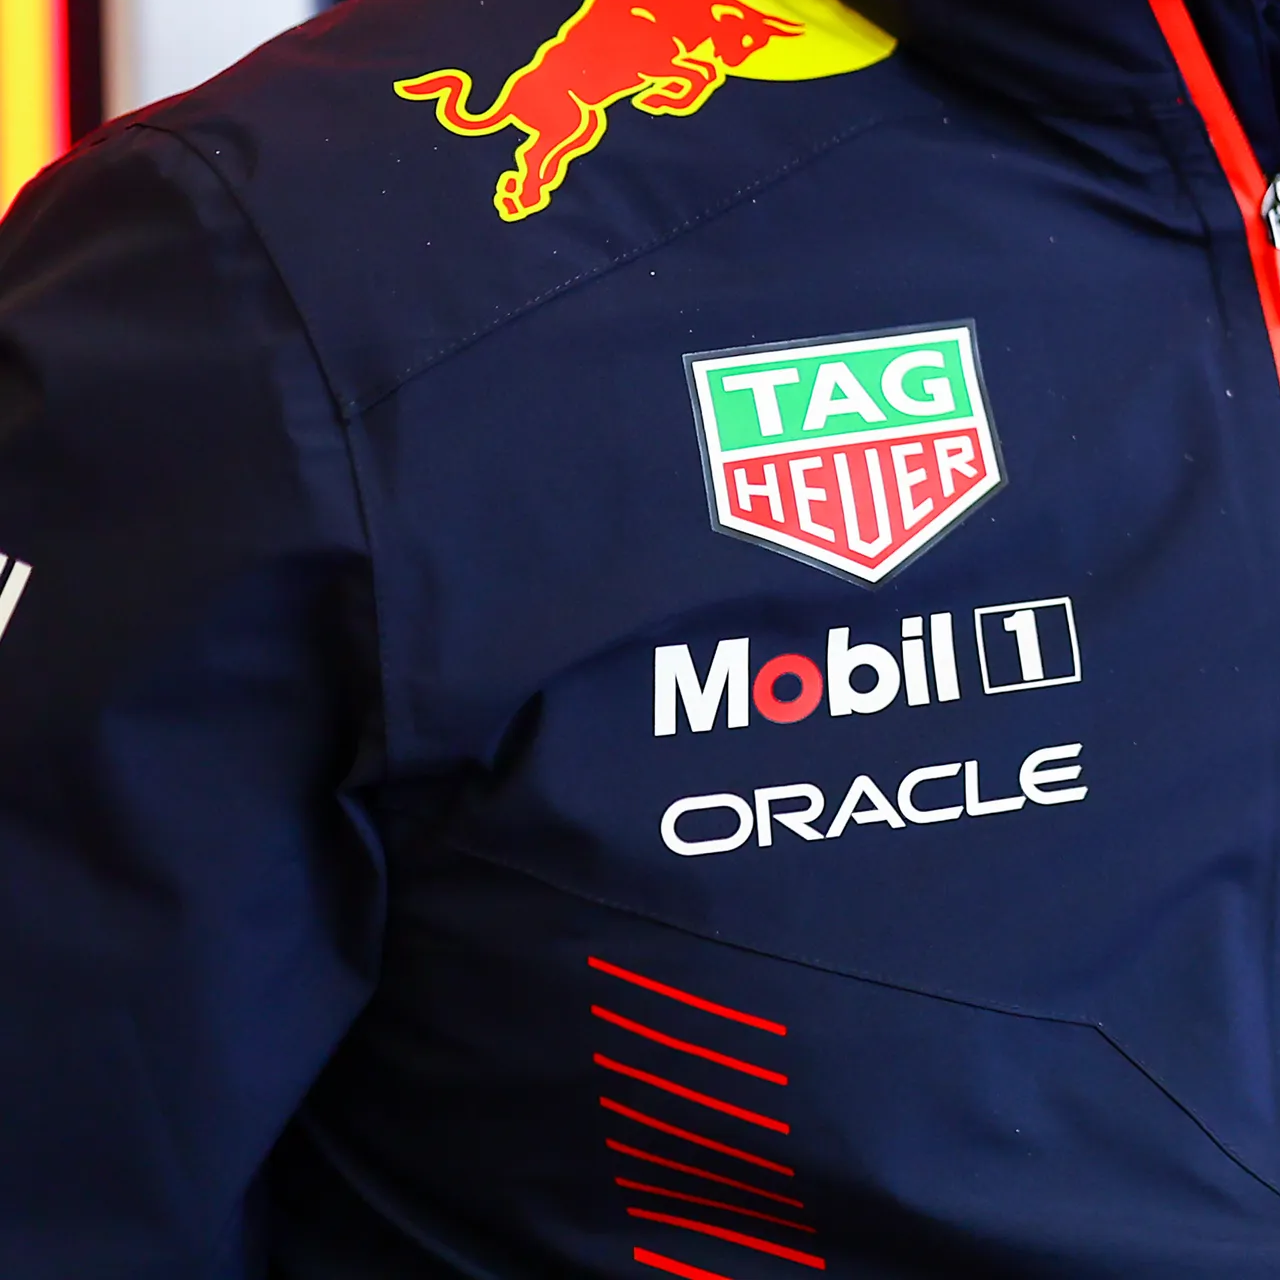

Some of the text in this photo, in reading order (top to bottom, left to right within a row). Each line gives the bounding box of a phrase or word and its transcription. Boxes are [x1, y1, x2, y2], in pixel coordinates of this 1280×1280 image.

[722, 349, 956, 437] TAG
[730, 435, 980, 560] HEUER
[653, 610, 961, 737] Mobil
[660, 742, 1089, 857] ORACLE
